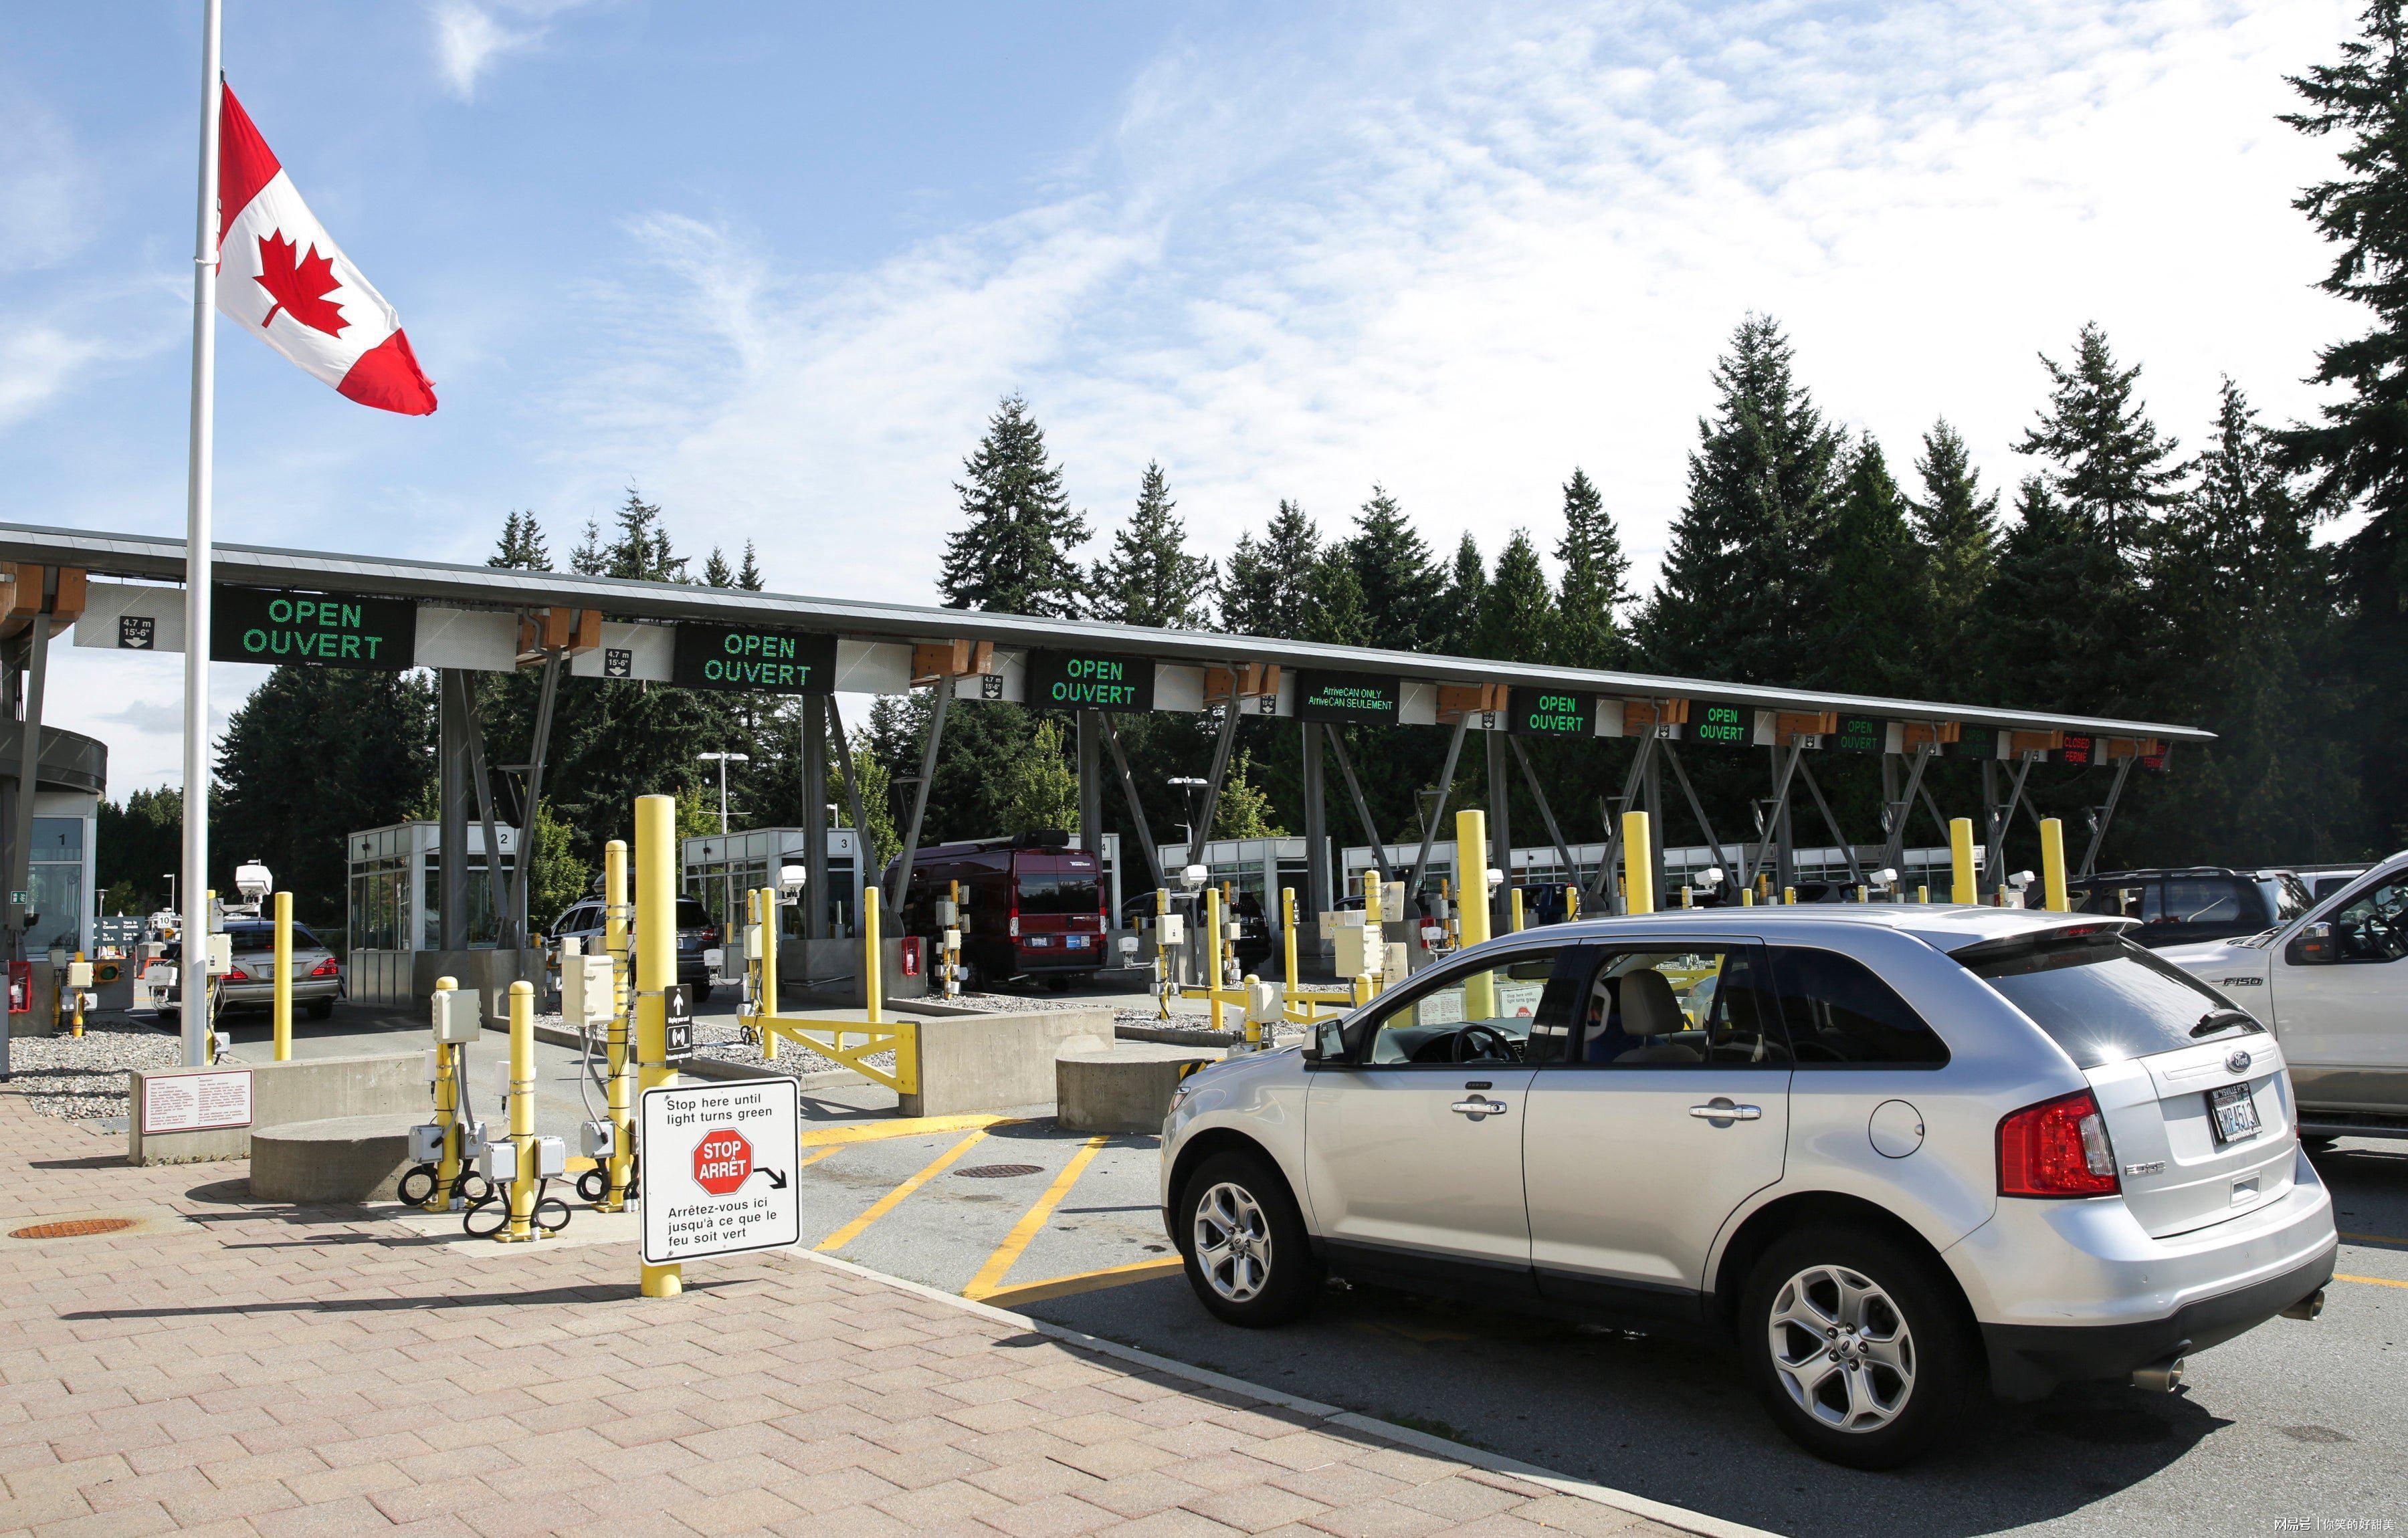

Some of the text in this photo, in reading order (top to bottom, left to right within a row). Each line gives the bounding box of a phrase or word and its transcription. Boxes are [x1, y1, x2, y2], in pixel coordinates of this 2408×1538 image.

[269, 599, 361, 627] OPEN
[123, 619, 138, 627] 4.7
[243, 629, 383, 659] OUVERT
[724, 634, 795, 658] OPEN
[704, 660, 811, 686] OUVERT
[1067, 659, 1122, 680] OPEN
[1052, 682, 1135, 704] OUVERT
[1323, 686, 1382, 699] ArriveCAN ONLY
[1308, 695, 1393, 710] ArriveCAN SEULEMENT
[1539, 695, 1575, 712] OPEN
[1530, 713, 1583, 732] OUVERT
[1708, 707, 1738, 723] OPEN
[1700, 724, 1744, 740] OUVERT
[1847, 721, 1873, 734] OPEN
[1840, 736, 1878, 749] OUVERT
[2064, 737, 2090, 749] CLOSED
[2065, 750, 2087, 763] FERMÉ
[58, 834, 65, 846] 1
[500, 834, 508, 844] 2
[841, 839, 847, 848] 3
[1102, 843, 1106, 852] 4
[2234, 1053, 2249, 1067] Ford
[667, 1093, 761, 1111] Stop here until
[667, 1108, 772, 1126] light turns green
[704, 1140, 741, 1160] STOP
[699, 1157, 746, 1180] ARRÊT
[668, 1196, 767, 1218] Arrêtez-vous ici
[668, 1210, 777, 1234] jusqu'à ce que le
[668, 1228, 746, 1246] feu soit vert
